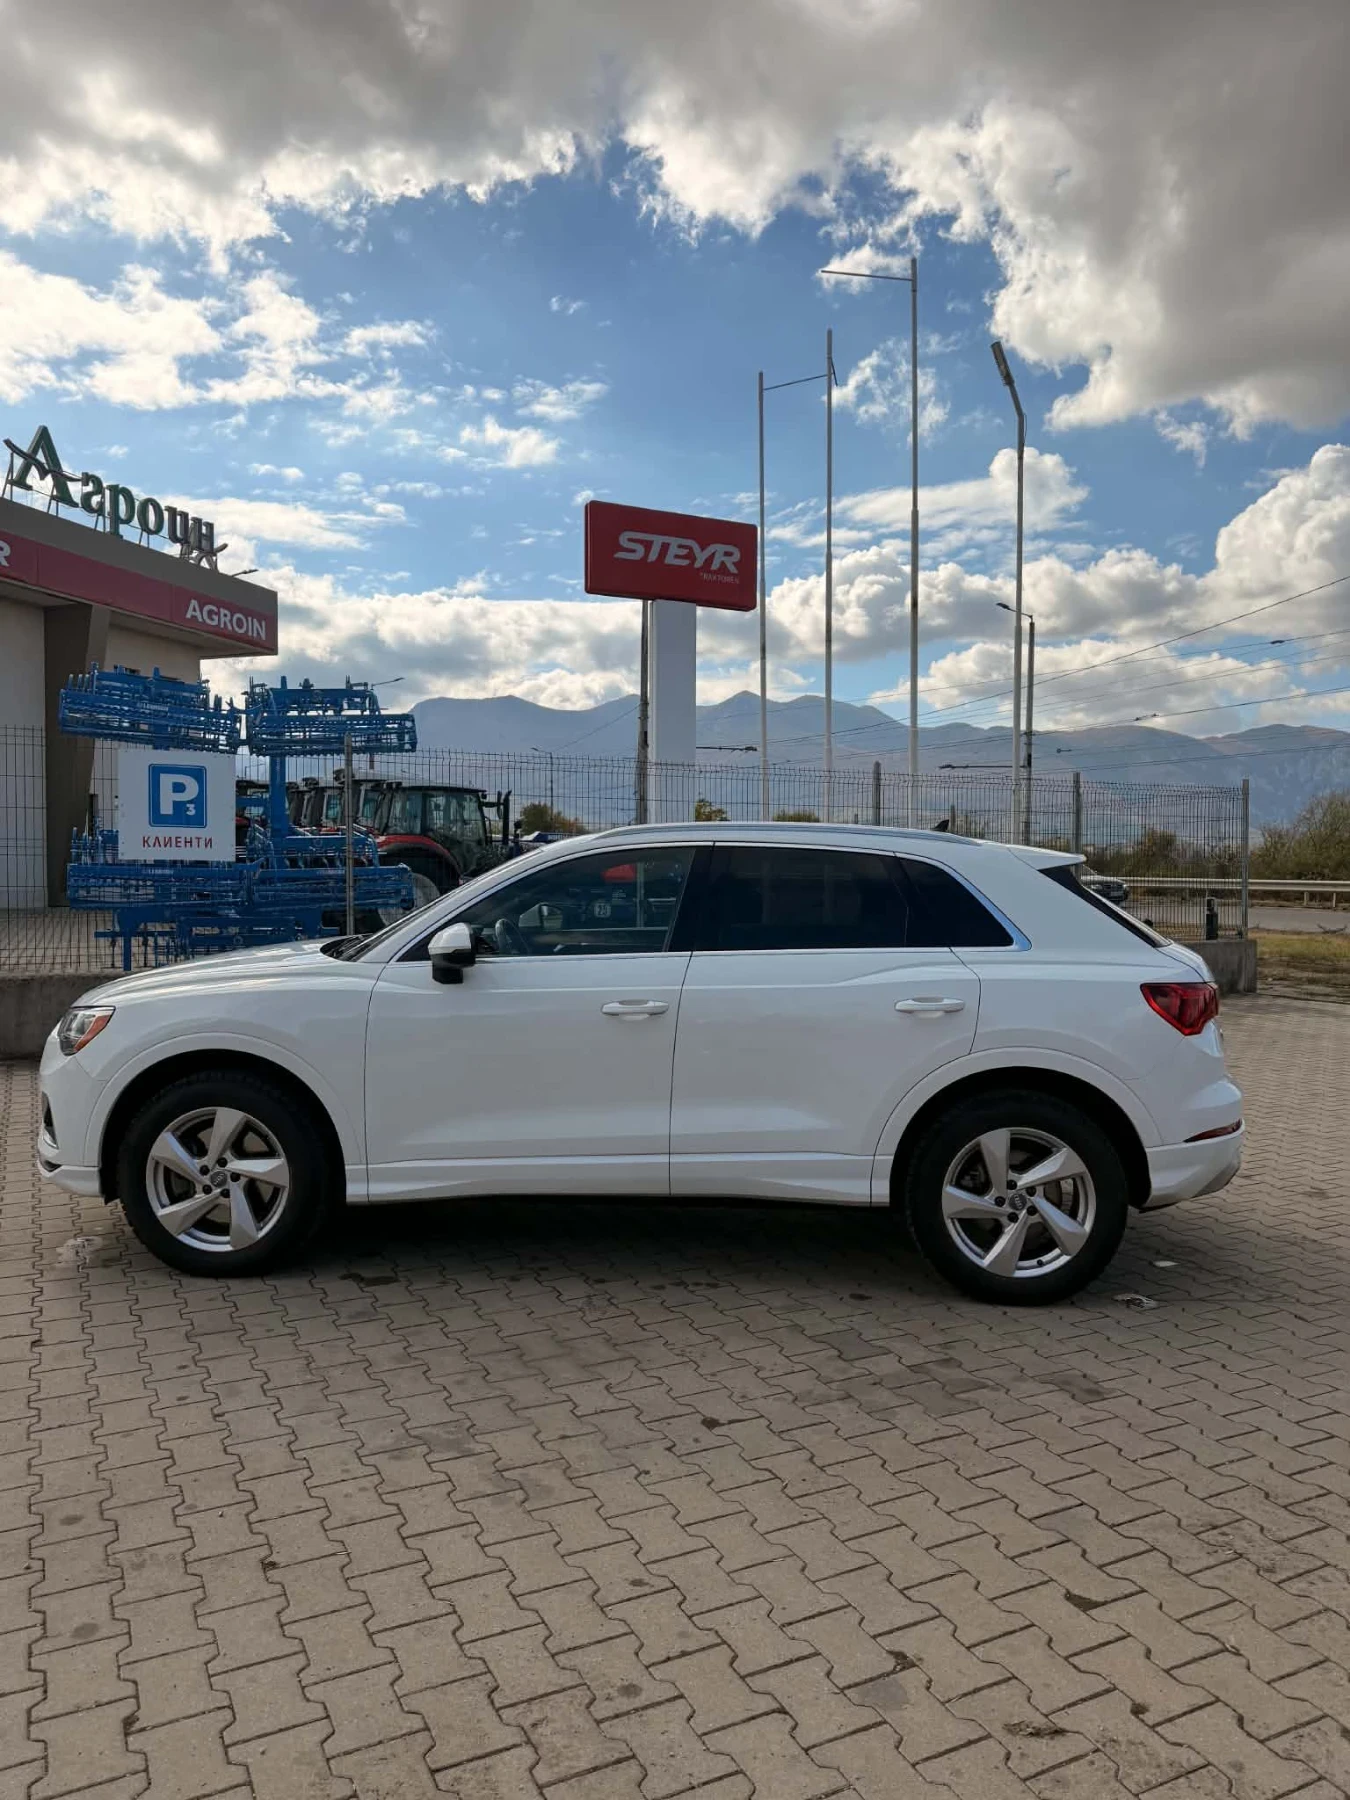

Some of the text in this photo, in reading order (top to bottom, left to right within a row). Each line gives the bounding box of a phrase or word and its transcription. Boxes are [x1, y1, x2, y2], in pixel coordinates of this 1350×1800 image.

[614, 531, 741, 574] STEYR
[186, 599, 267, 640] AGROIN
[160, 773, 199, 815] P
[186, 803, 196, 816] 3
[142, 836, 213, 849] КЛИЕНТИ
